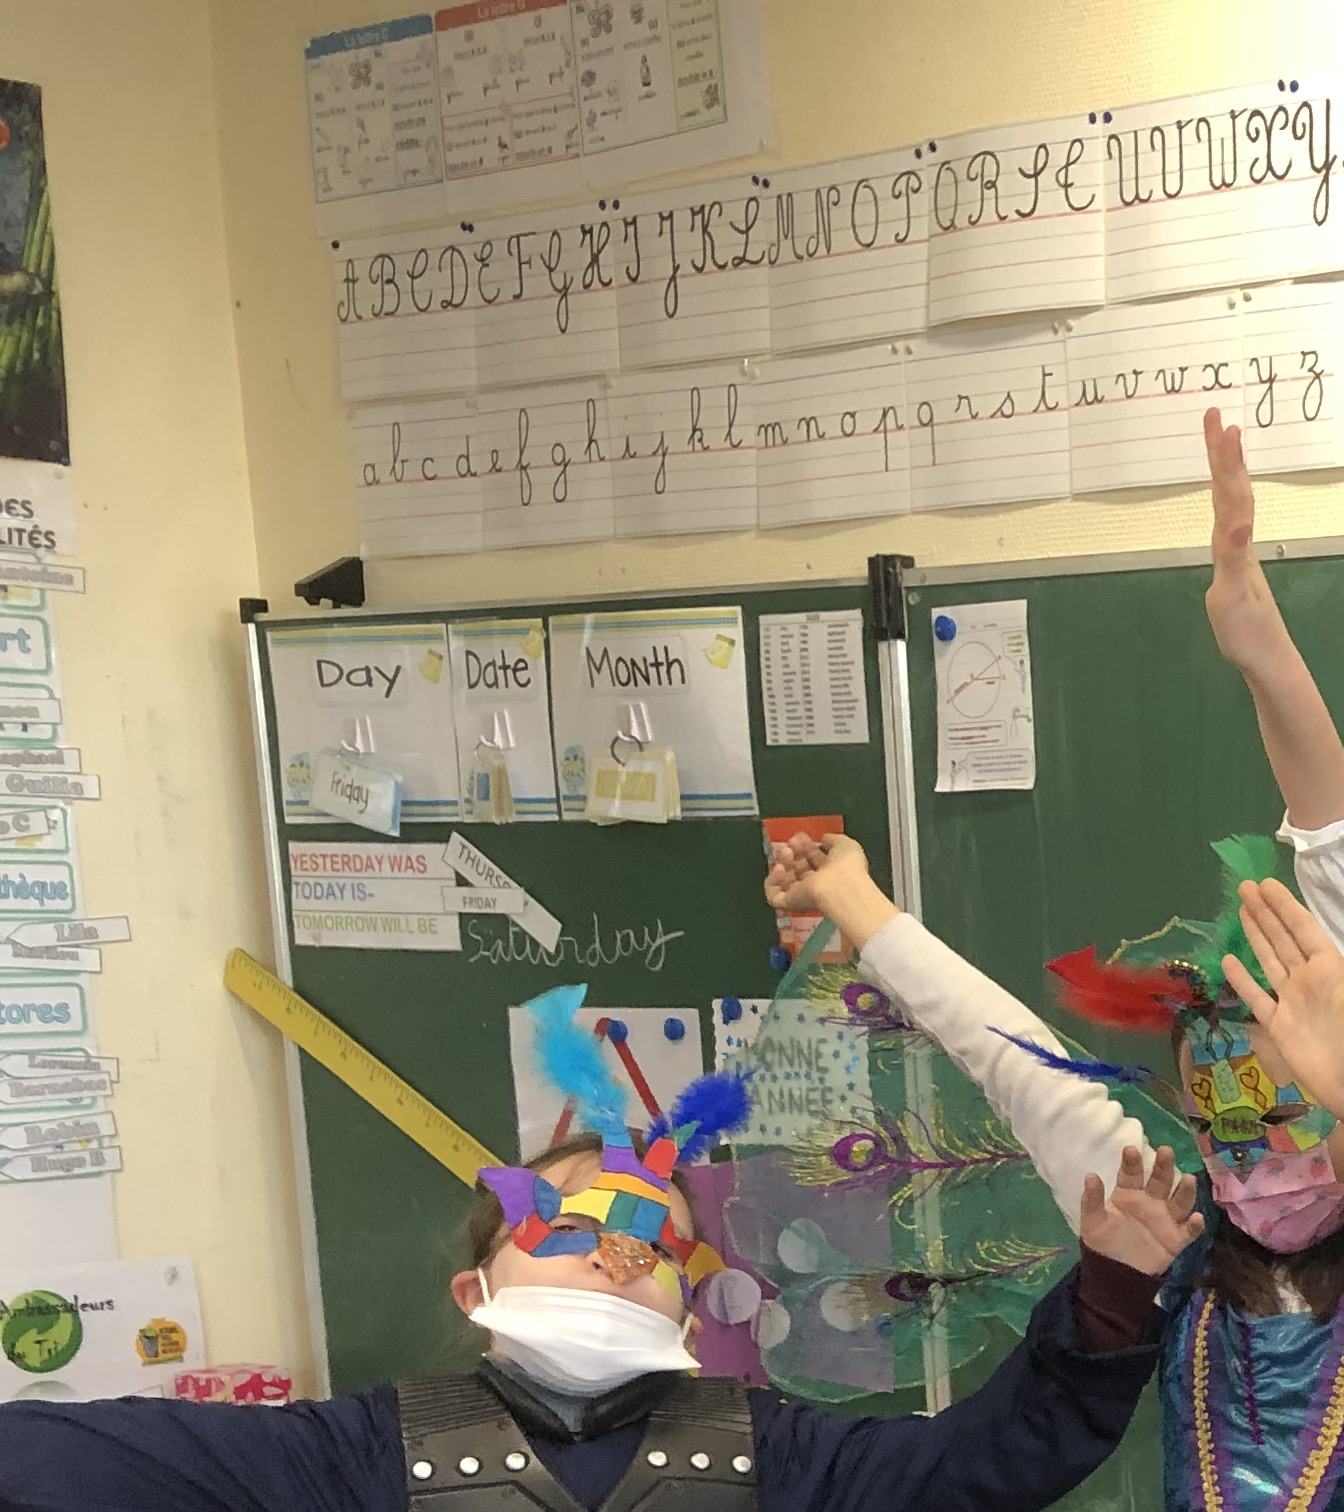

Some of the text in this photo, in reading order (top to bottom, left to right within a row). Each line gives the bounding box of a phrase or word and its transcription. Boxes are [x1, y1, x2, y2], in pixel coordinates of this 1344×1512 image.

[0, 498, 34, 519] ES
[316, 659, 402, 698] Day
[465, 650, 531, 690] Date
[586, 646, 686, 687] Month
[331, 771, 369, 813] Friday
[290, 853, 427, 875] YESTERDAY WAS
[293, 881, 348, 901] TODAY
[462, 895, 497, 909] FRIDAY
[295, 912, 438, 934] TOMORROW WILL BE
[748, 1037, 829, 1073] ONNE
